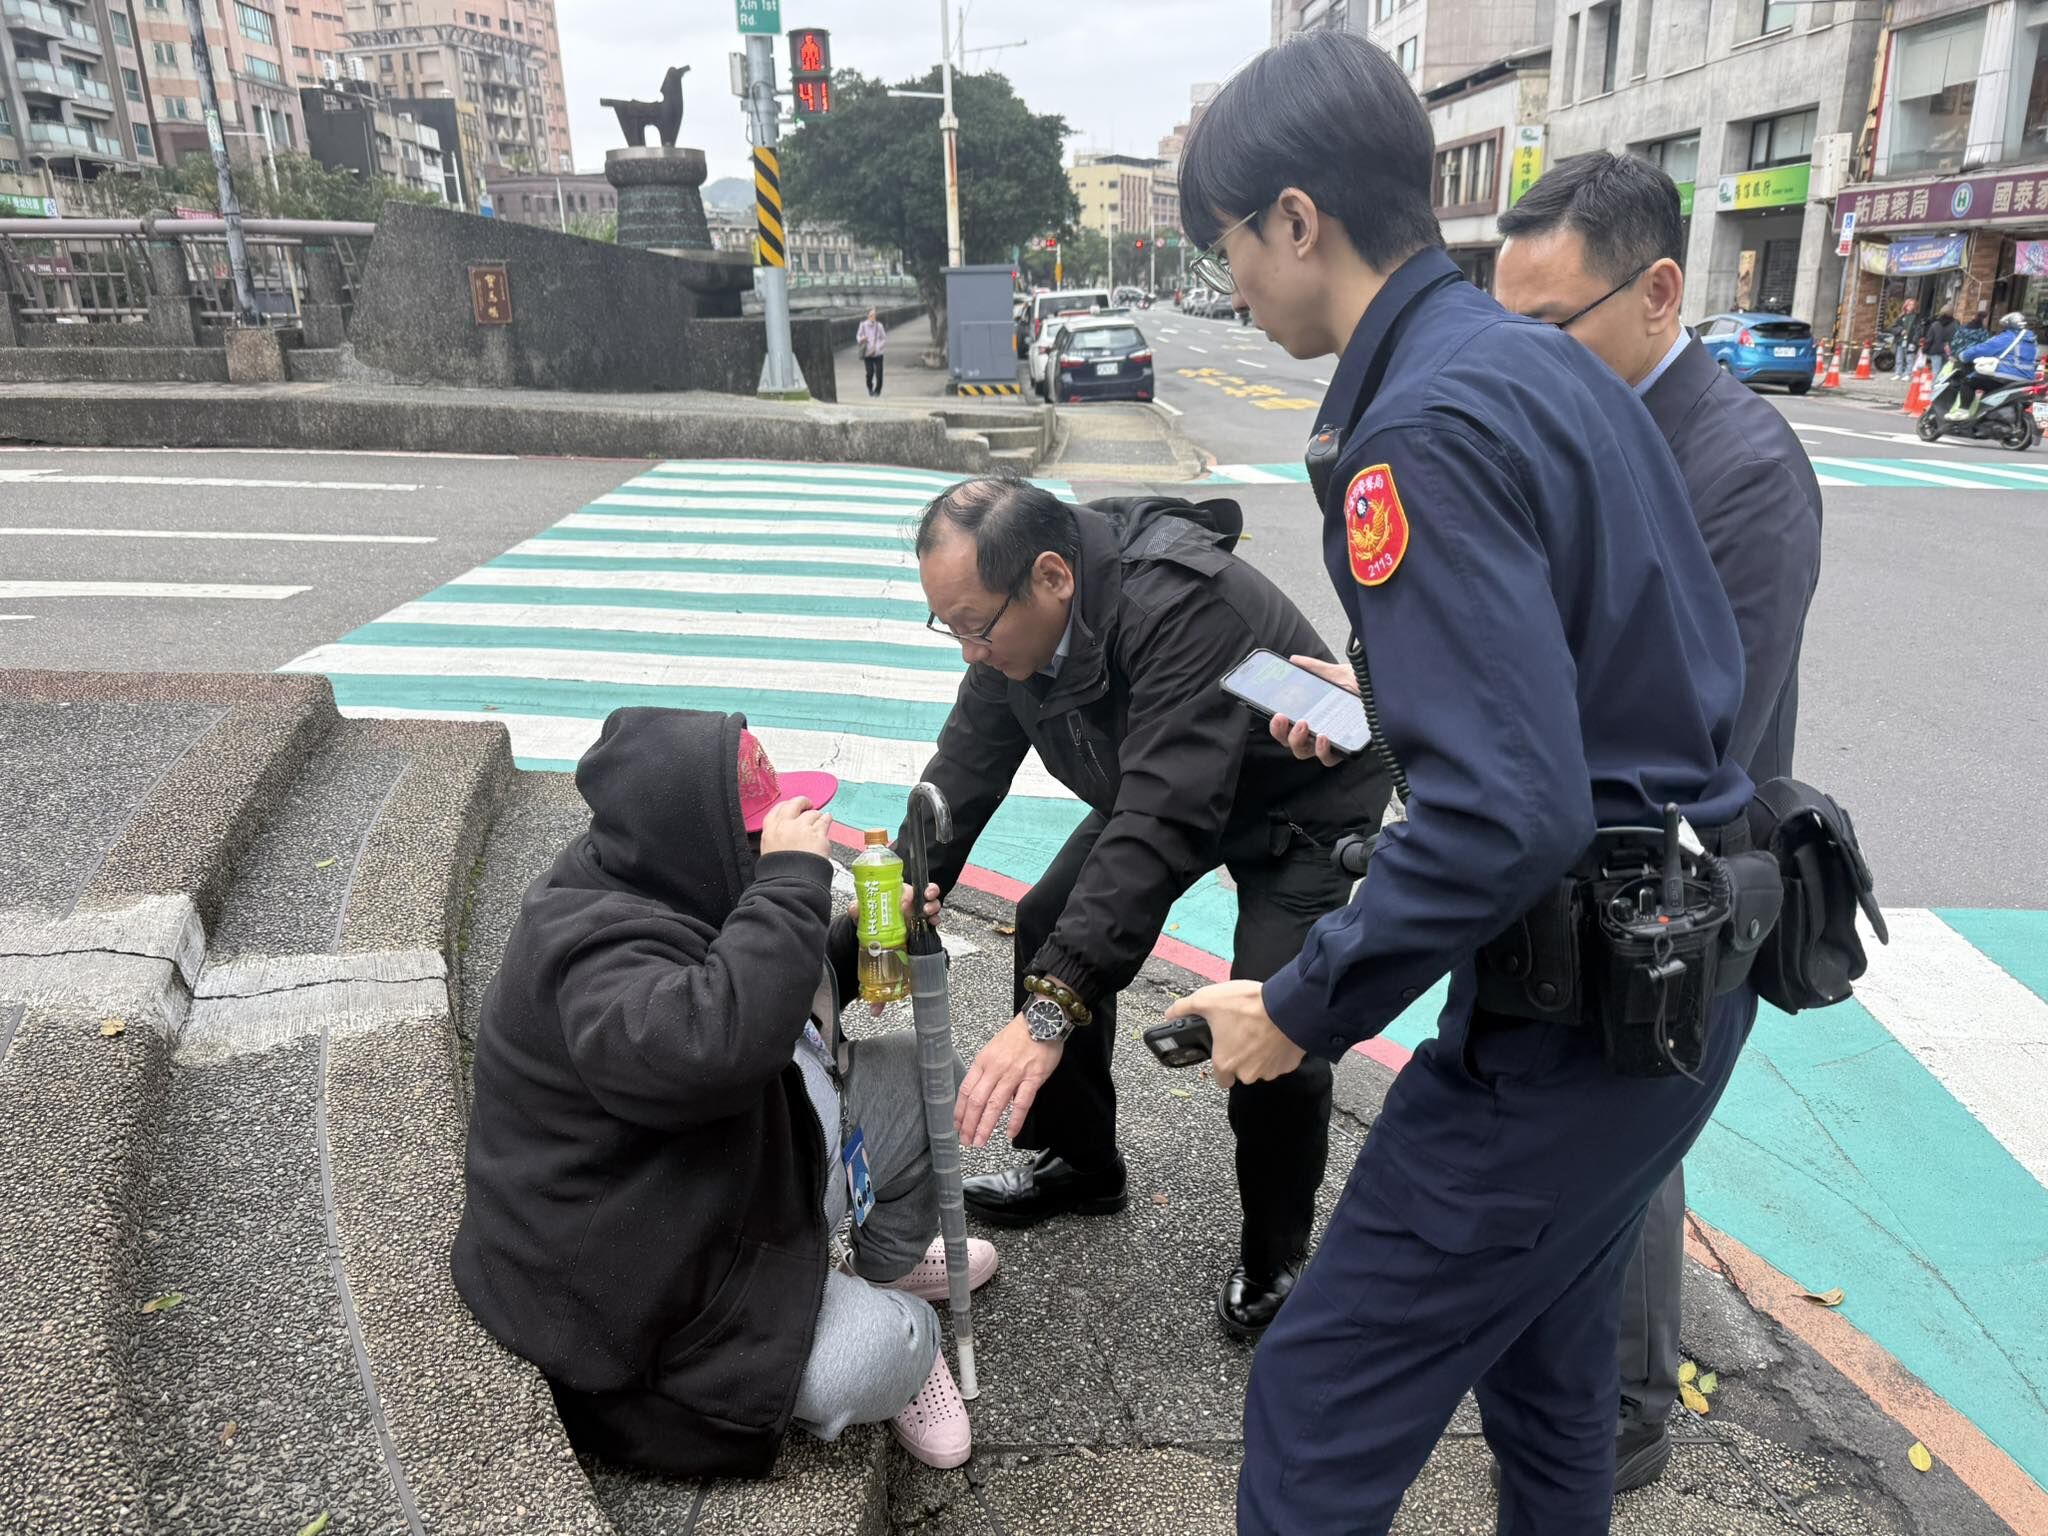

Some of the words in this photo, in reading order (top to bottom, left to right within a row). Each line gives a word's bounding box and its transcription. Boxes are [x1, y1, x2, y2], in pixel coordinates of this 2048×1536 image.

[740, 0, 757, 10] Xin
[762, 0, 777, 11] 1st
[798, 82, 829, 112] 41
[1368, 553, 1393, 578] 2113
